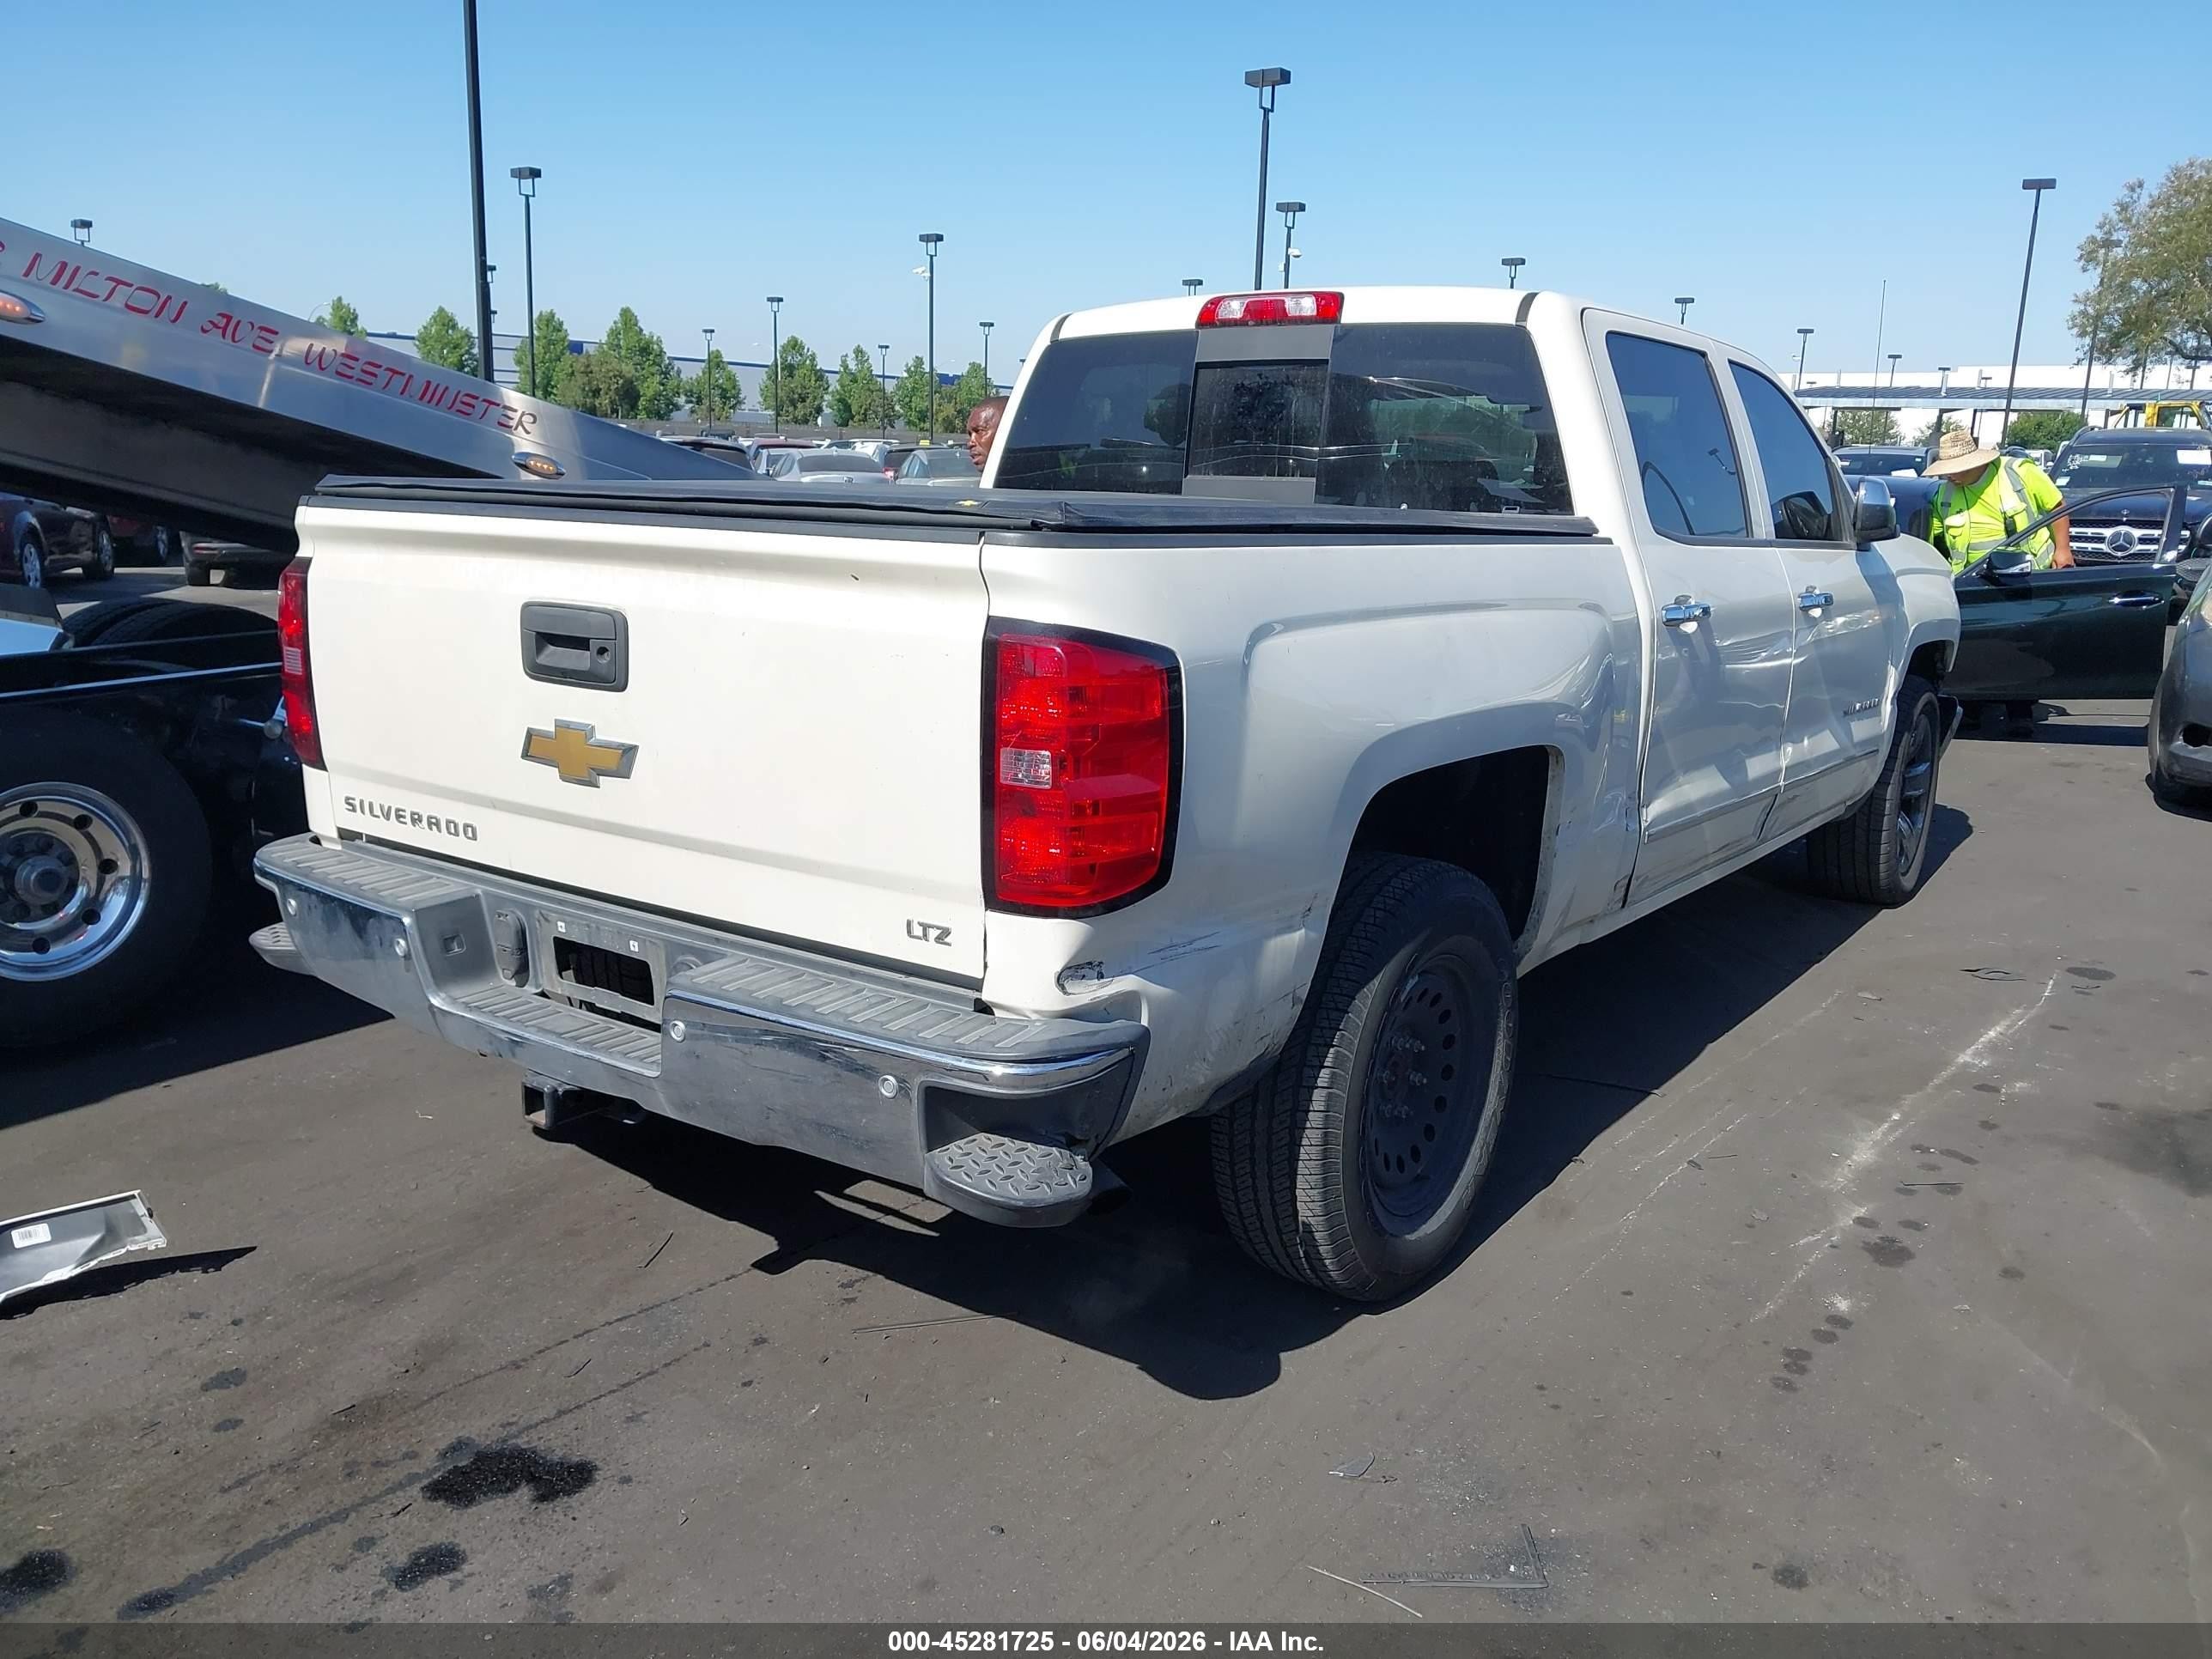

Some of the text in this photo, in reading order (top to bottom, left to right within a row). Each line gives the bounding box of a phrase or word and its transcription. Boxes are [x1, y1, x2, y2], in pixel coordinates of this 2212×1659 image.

[21, 252, 188, 323] MILTON
[304, 343, 538, 434] WESTMINSTER
[343, 795, 477, 841] SILVERADO
[906, 919, 952, 946] LTZ
